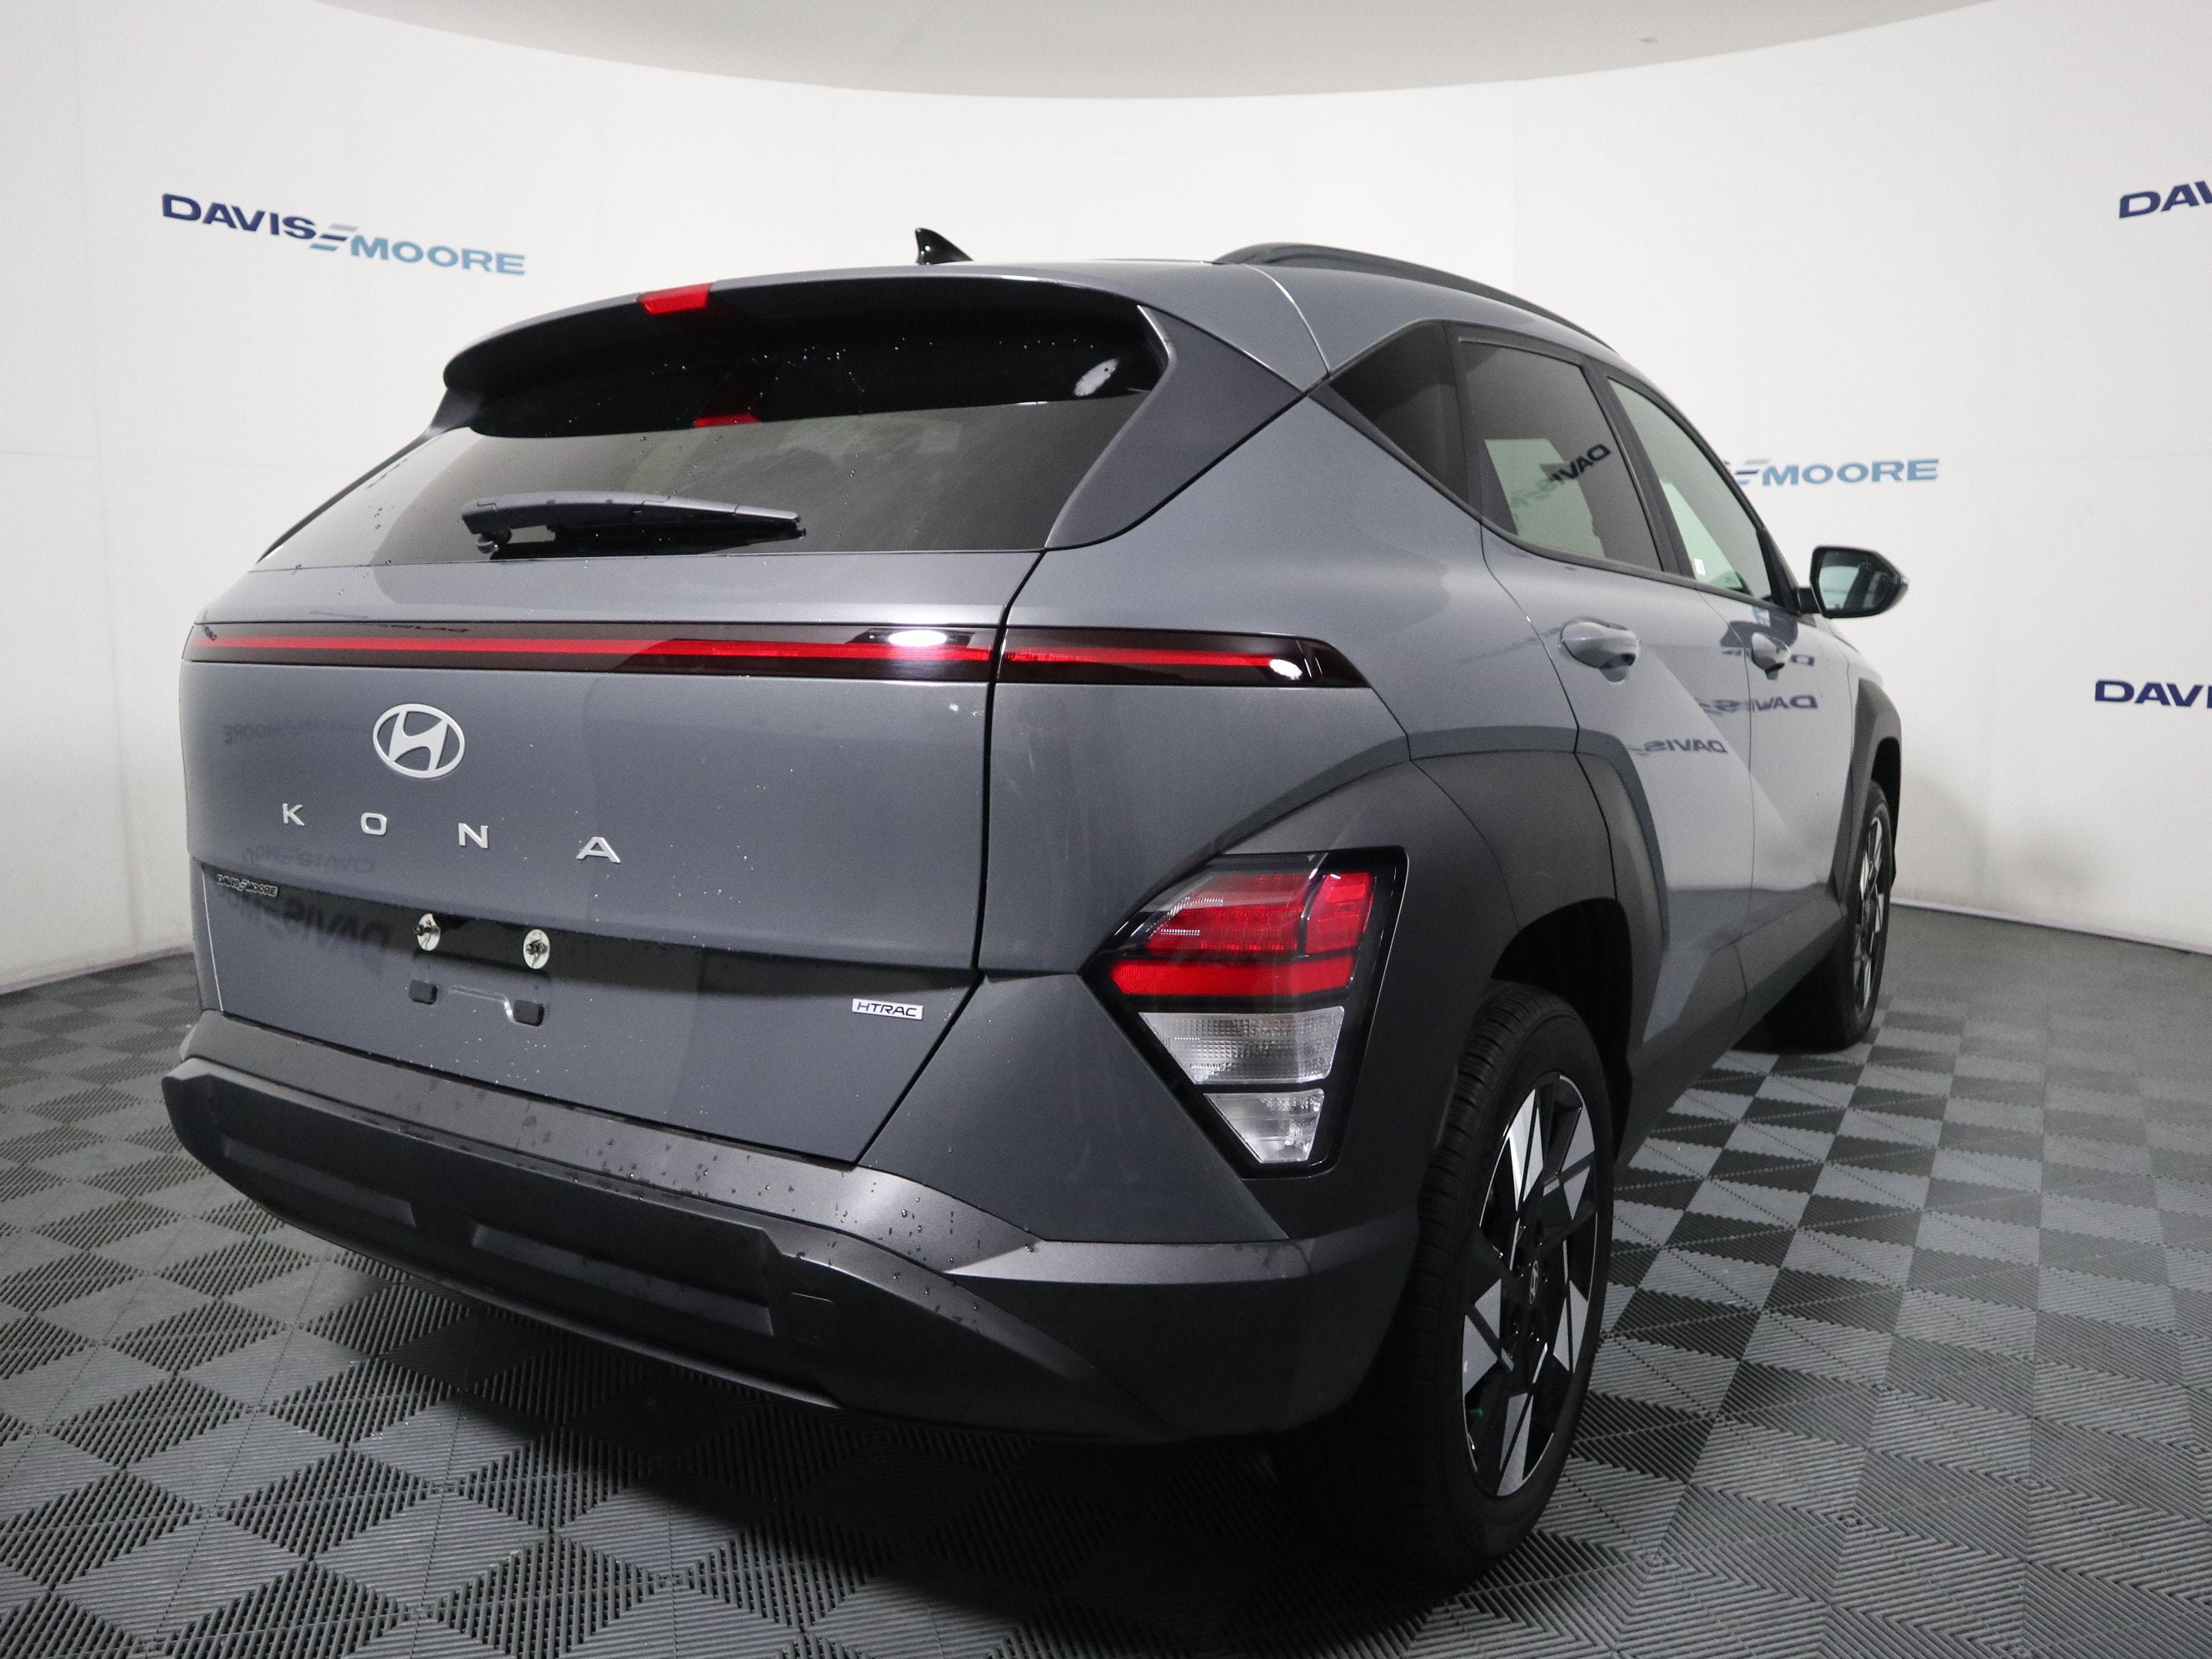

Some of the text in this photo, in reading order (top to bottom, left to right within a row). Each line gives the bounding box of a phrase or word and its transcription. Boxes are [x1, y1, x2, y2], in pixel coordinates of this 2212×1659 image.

[162, 192, 526, 276] DAVIS MOORE
[1761, 458, 1940, 486] MOORE
[281, 802, 620, 864] KONA
[856, 1001, 918, 1017] HTRAC
